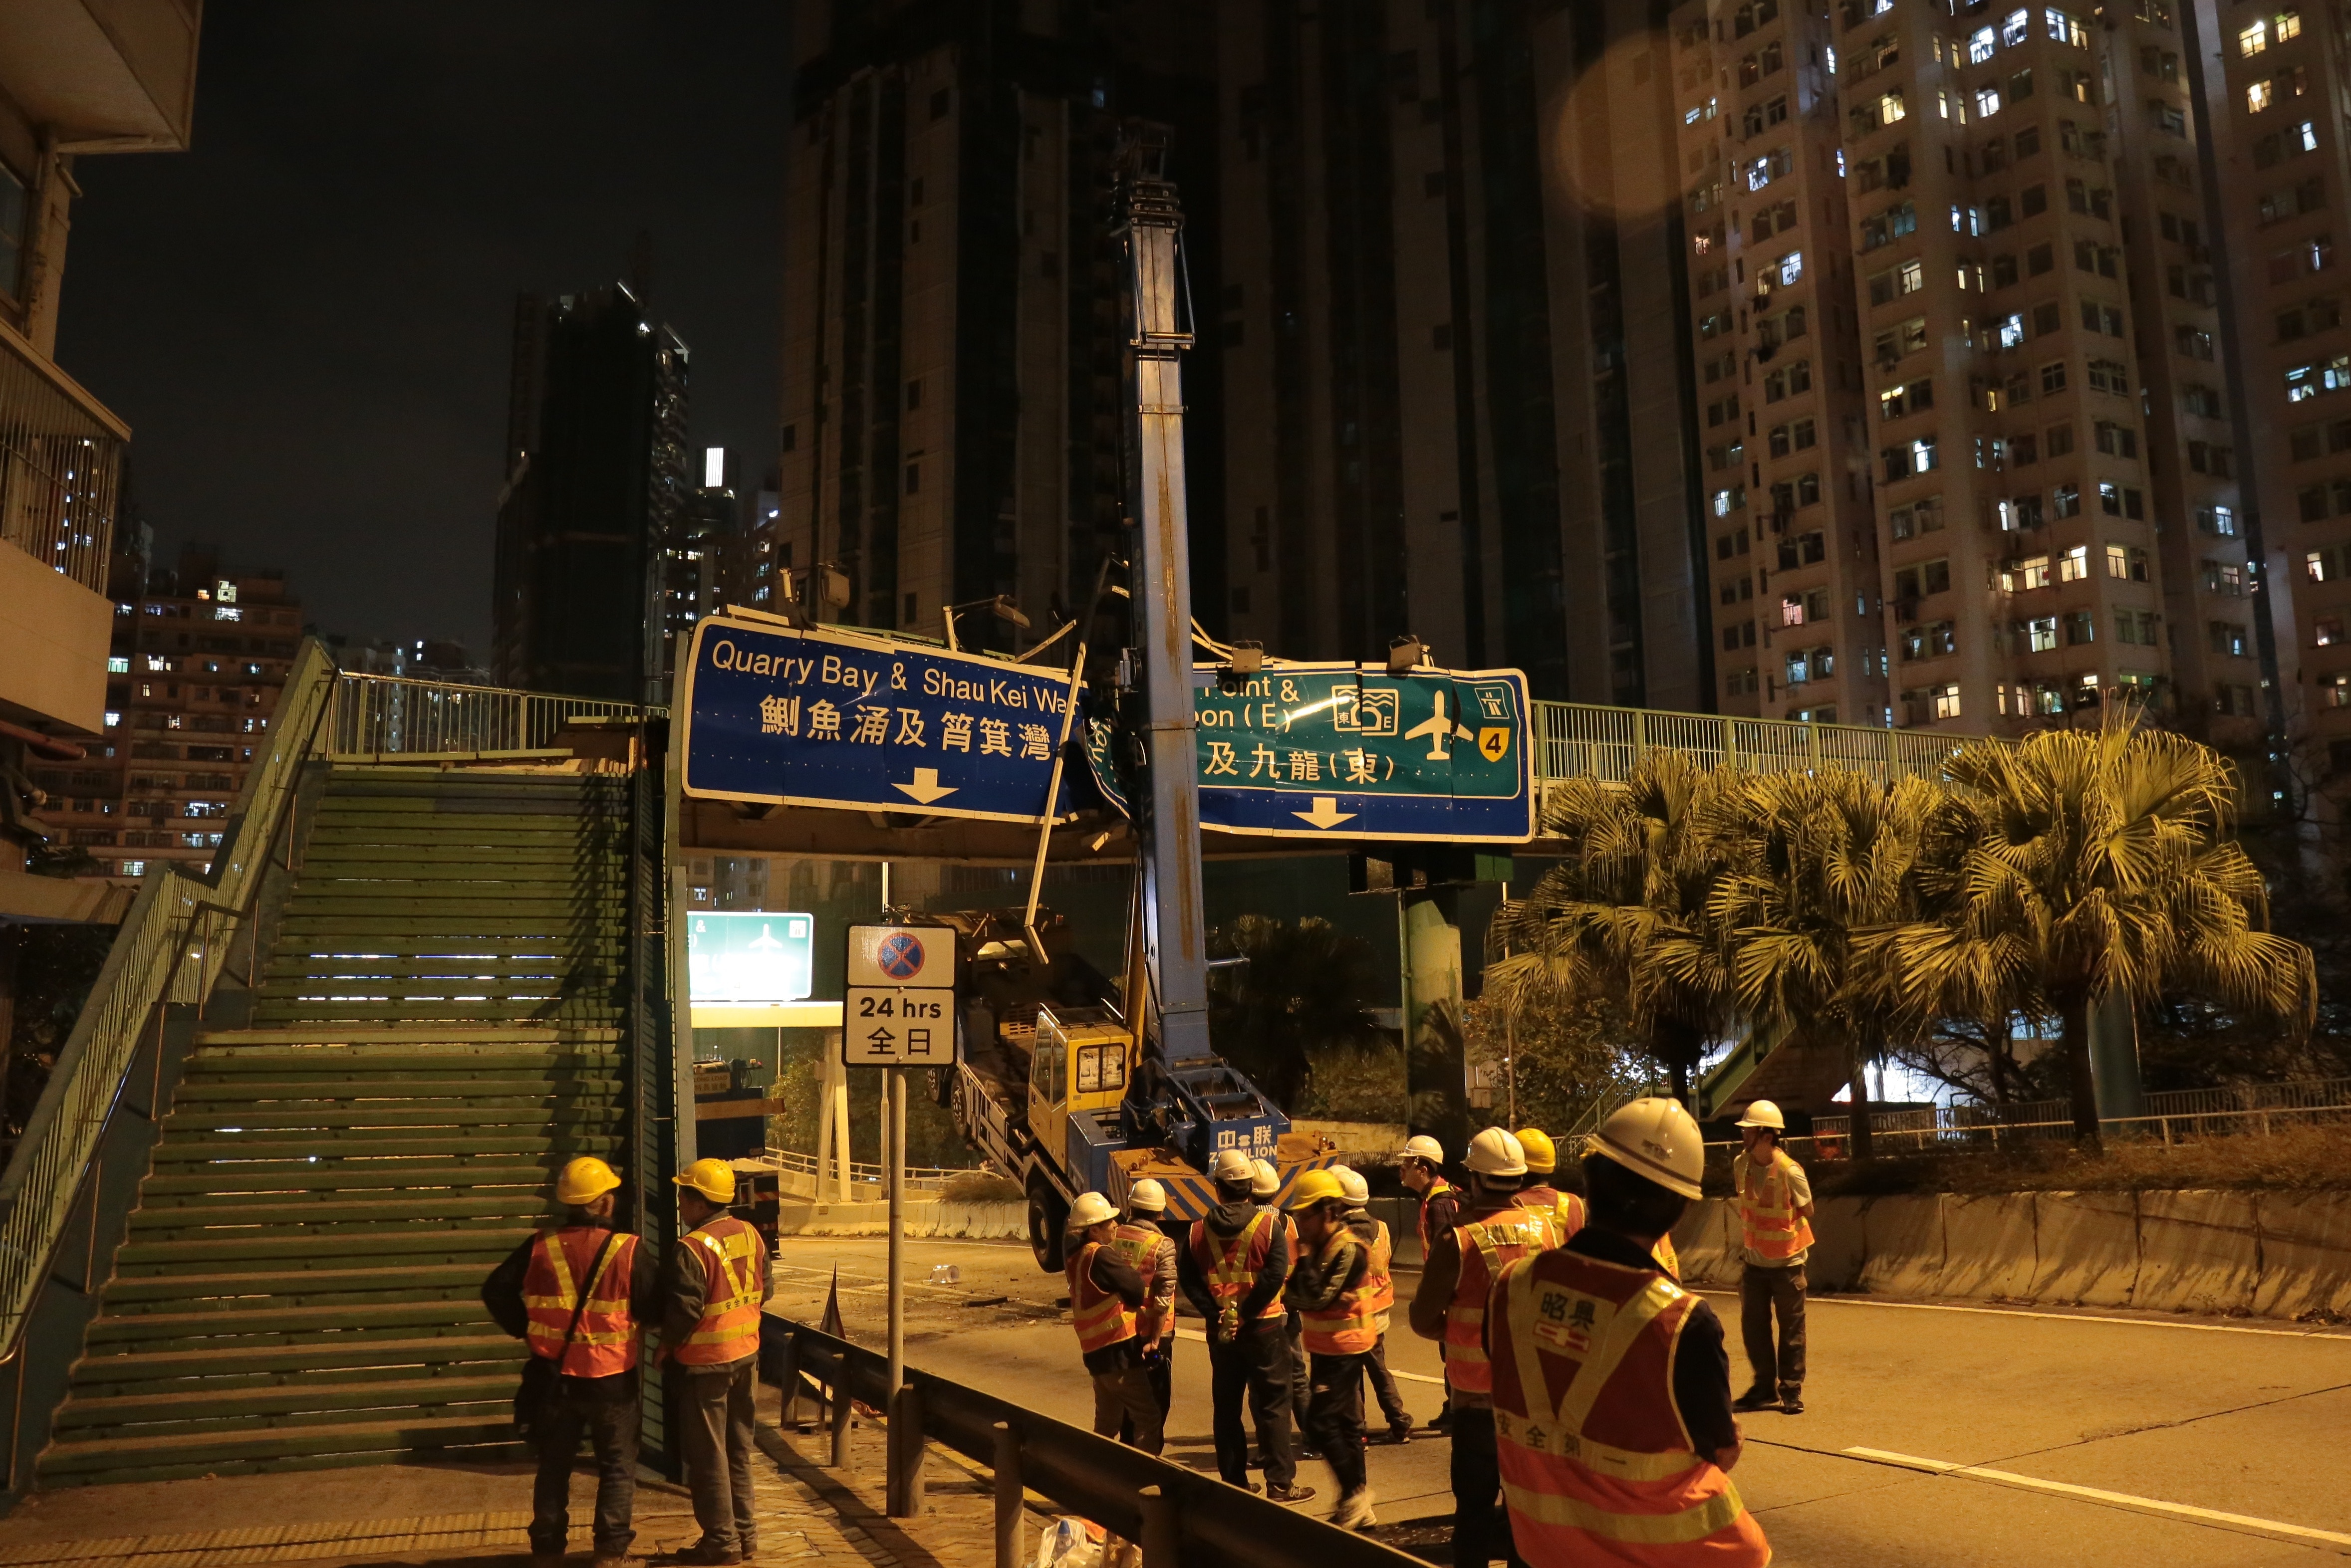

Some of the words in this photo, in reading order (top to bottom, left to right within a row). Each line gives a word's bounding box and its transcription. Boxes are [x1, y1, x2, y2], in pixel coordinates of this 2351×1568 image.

[712, 640, 814, 684] Quarry
[821, 655, 879, 696] Bay
[891, 662, 908, 690] &
[923, 668, 984, 702] Shau
[991, 678, 1028, 708] Kei
[1281, 679, 1301, 702] &
[1338, 712, 1350, 724] 東
[1383, 716, 1392, 728] E
[1485, 733, 1502, 754] 4
[696, 919, 707, 933] &
[859, 997, 894, 1018] 24
[902, 997, 942, 1018] hrs
[867, 1026, 931, 1056] 全日
